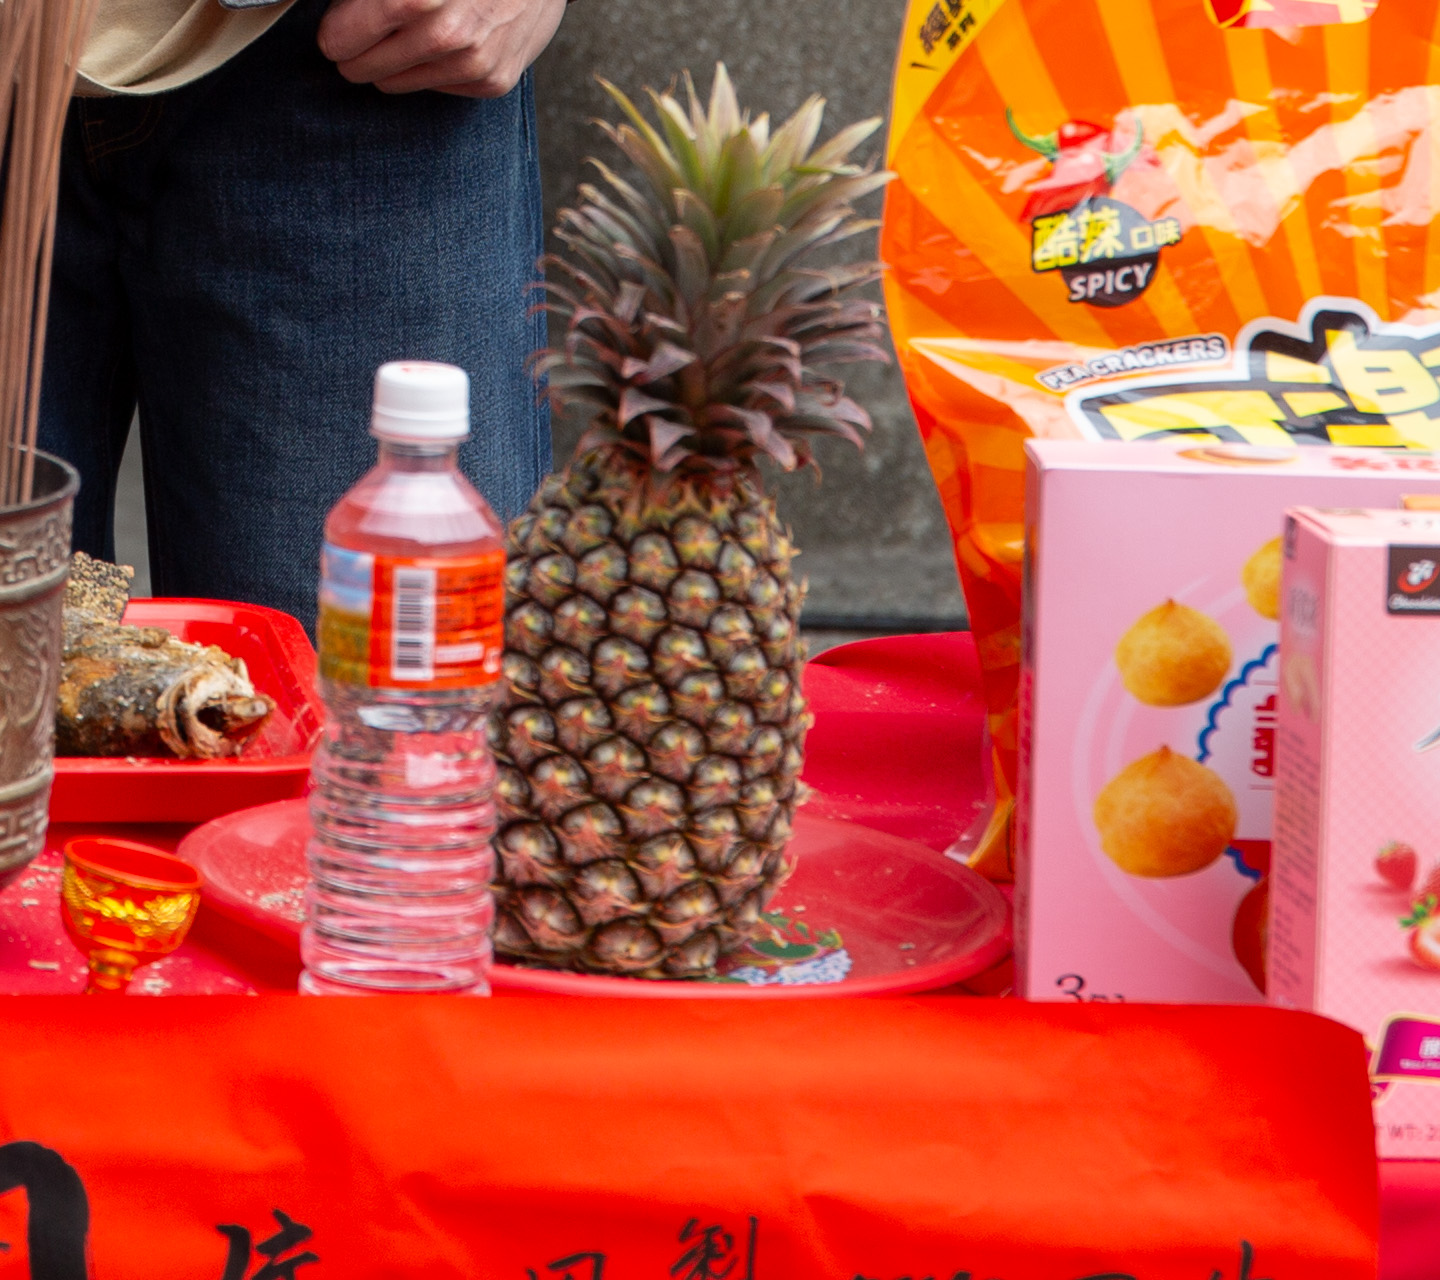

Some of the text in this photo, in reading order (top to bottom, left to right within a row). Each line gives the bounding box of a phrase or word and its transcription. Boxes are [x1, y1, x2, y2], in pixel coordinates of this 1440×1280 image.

[1069, 262, 1152, 301] SPICY
[1039, 336, 1226, 389] PEA CRACKERS
